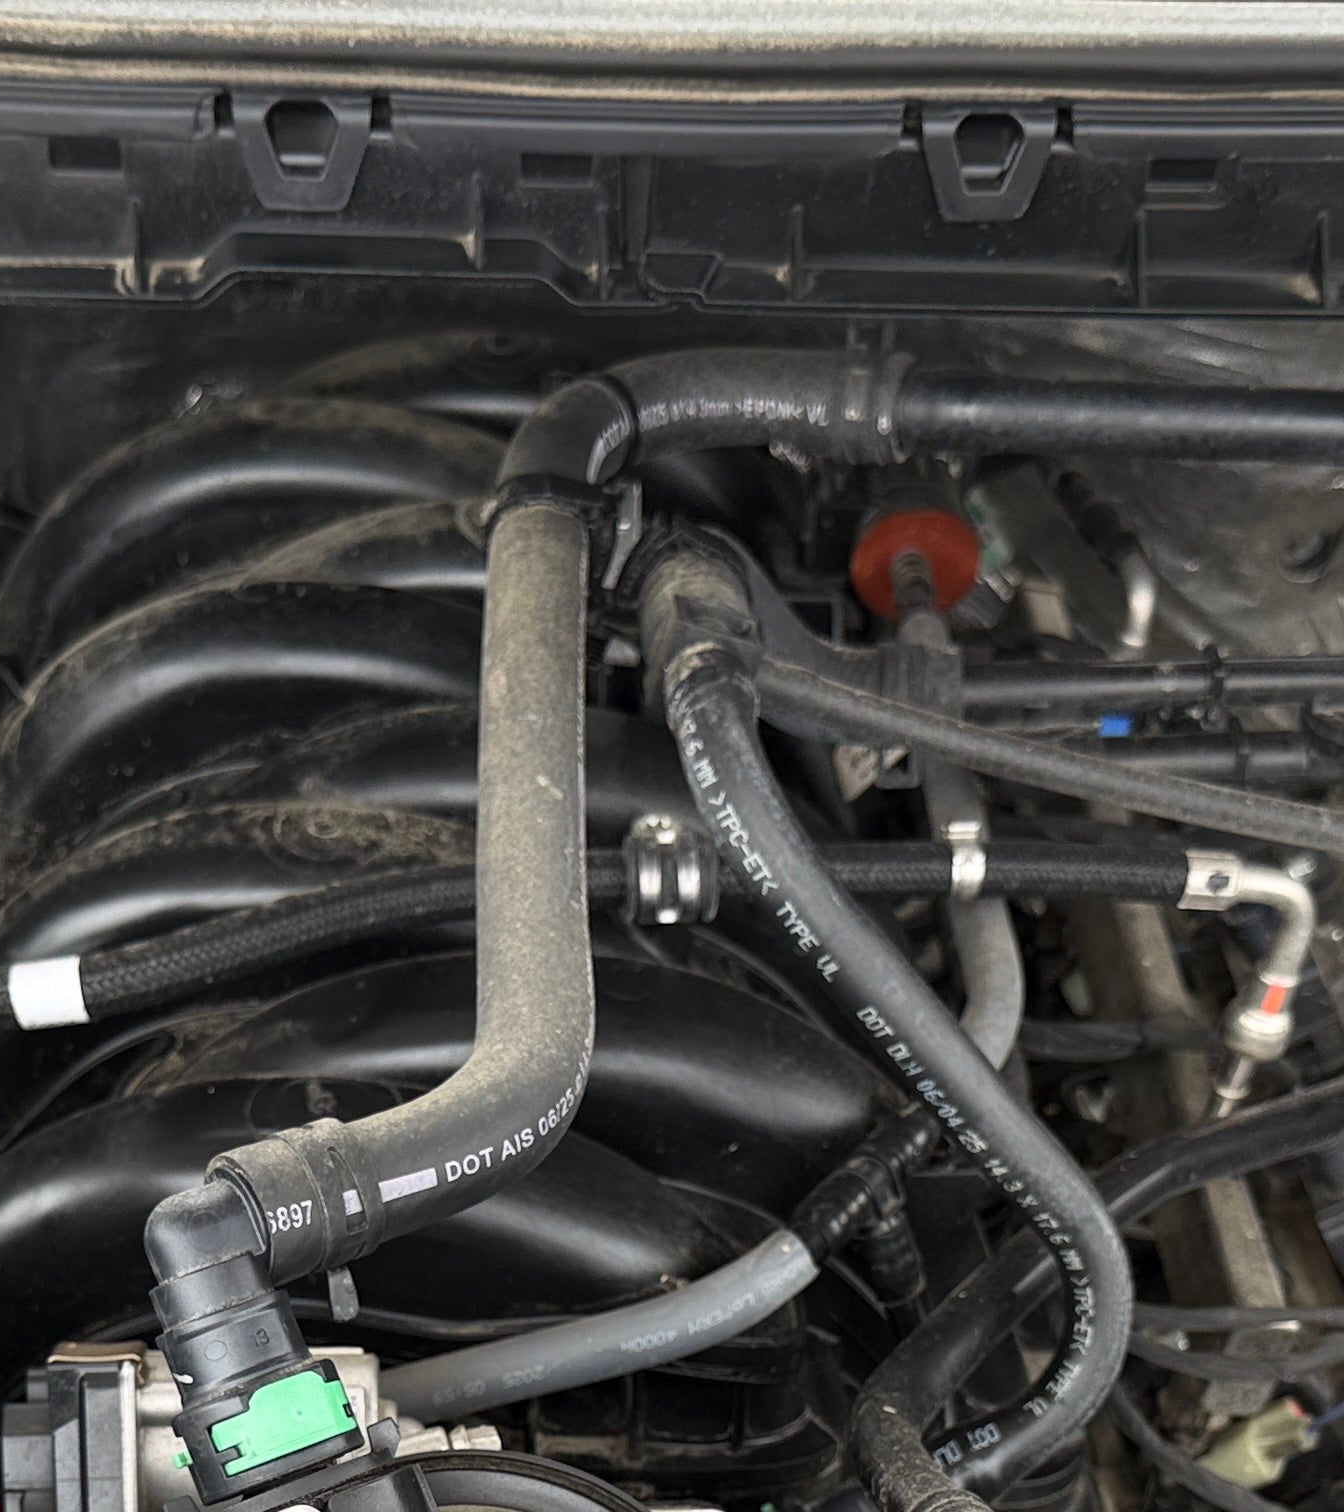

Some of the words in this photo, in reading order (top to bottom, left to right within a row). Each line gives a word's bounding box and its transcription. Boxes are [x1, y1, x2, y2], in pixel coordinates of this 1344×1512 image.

[775, 899, 822, 952] TYPE
[856, 1005, 896, 1039] DOT
[444, 1146, 494, 1183] DOT
[501, 1127, 535, 1161] AIS
[537, 1086, 575, 1136] 06/25
